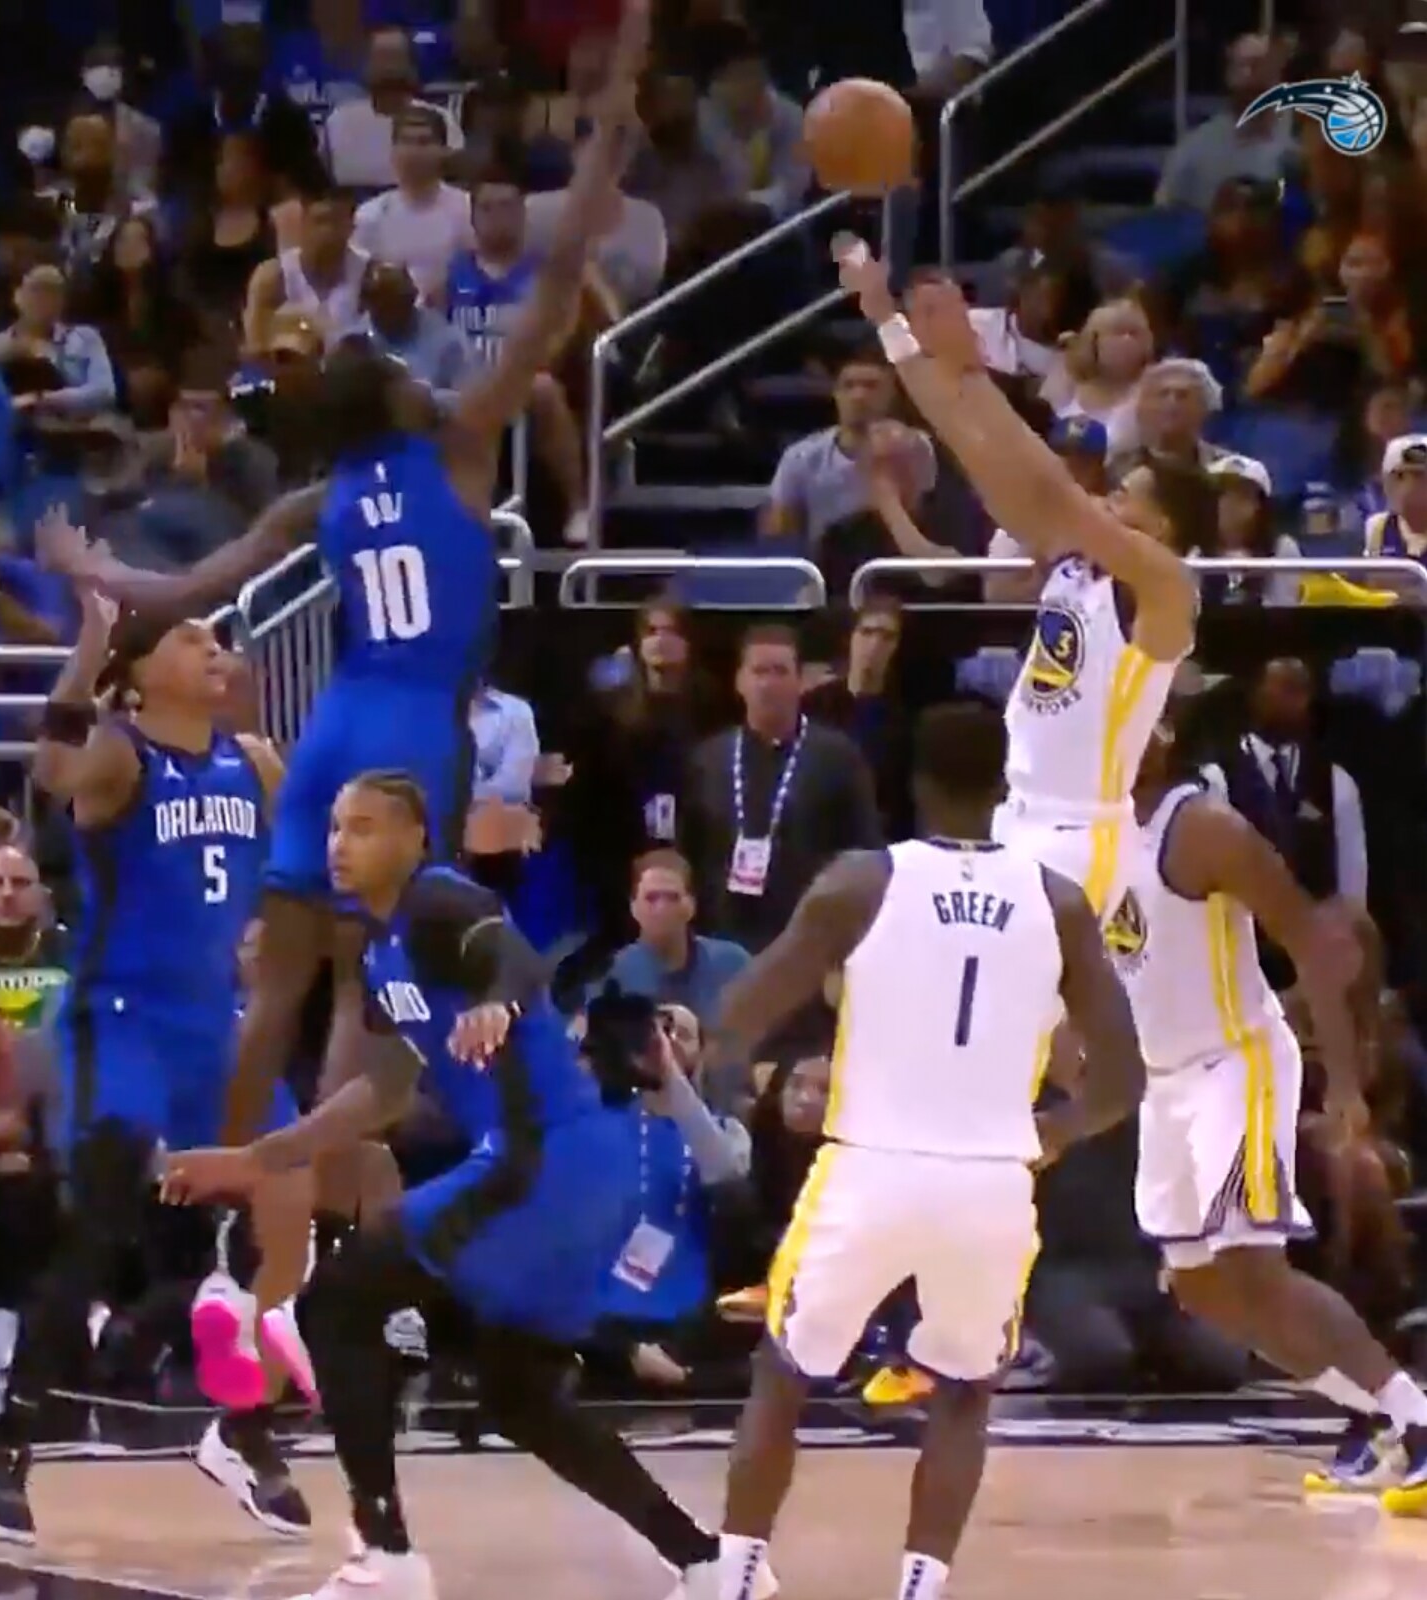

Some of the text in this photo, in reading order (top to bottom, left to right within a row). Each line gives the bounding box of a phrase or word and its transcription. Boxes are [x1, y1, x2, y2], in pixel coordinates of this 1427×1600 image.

[352, 545, 432, 640] 10
[1055, 630, 1074, 658] 3
[155, 794, 256, 844] ORLANDO
[203, 844, 228, 904] 5
[932, 890, 1015, 933] GREEN
[954, 955, 979, 1047] 1
